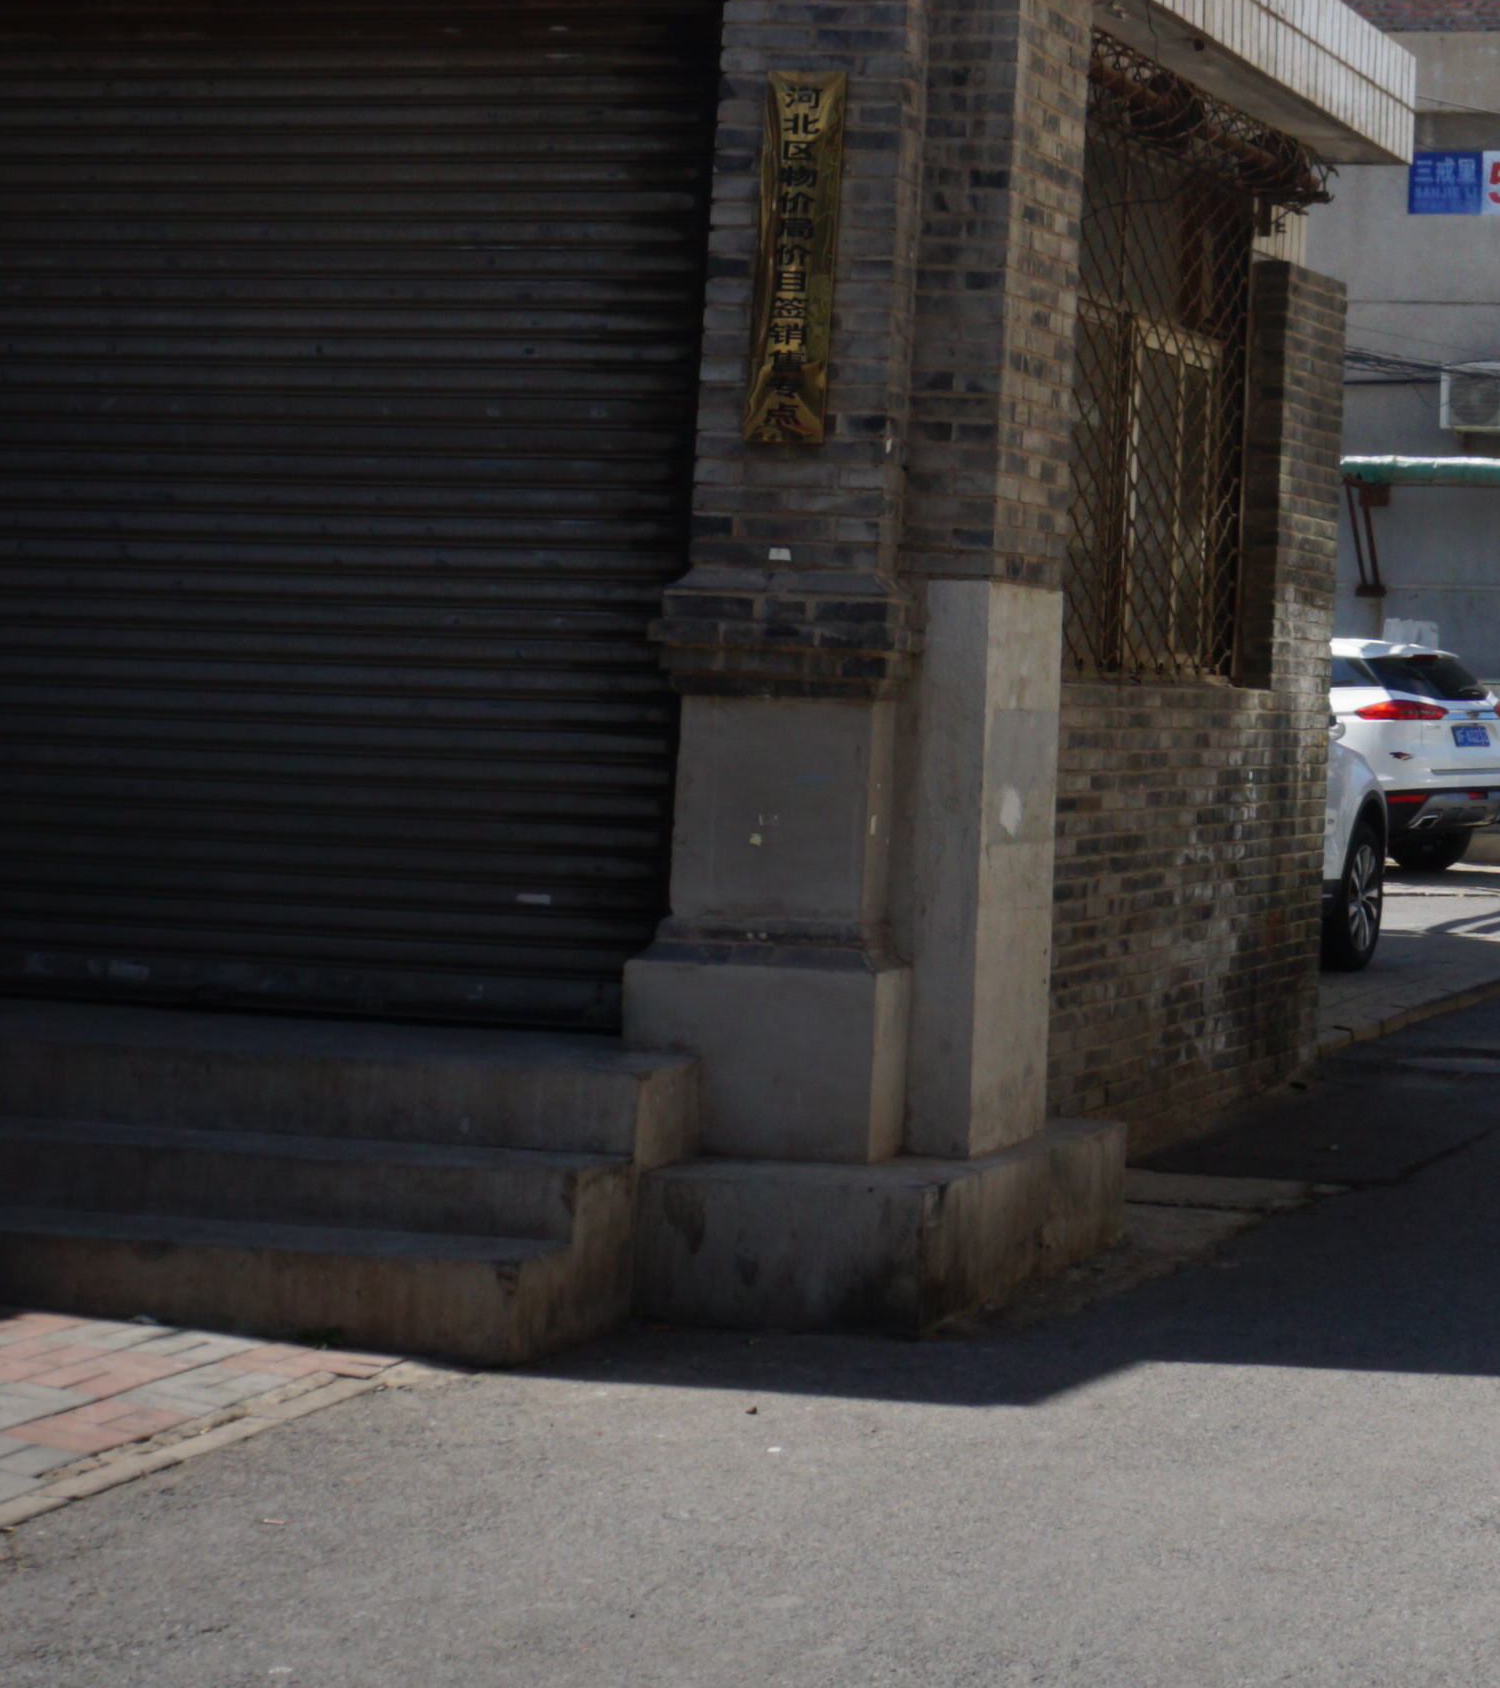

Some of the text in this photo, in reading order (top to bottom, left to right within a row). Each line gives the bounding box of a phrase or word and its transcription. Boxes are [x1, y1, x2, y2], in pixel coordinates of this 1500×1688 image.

[765, 86, 823, 425] 河北区物价局价目签销售专点
[1414, 157, 1477, 184] 三戒里
